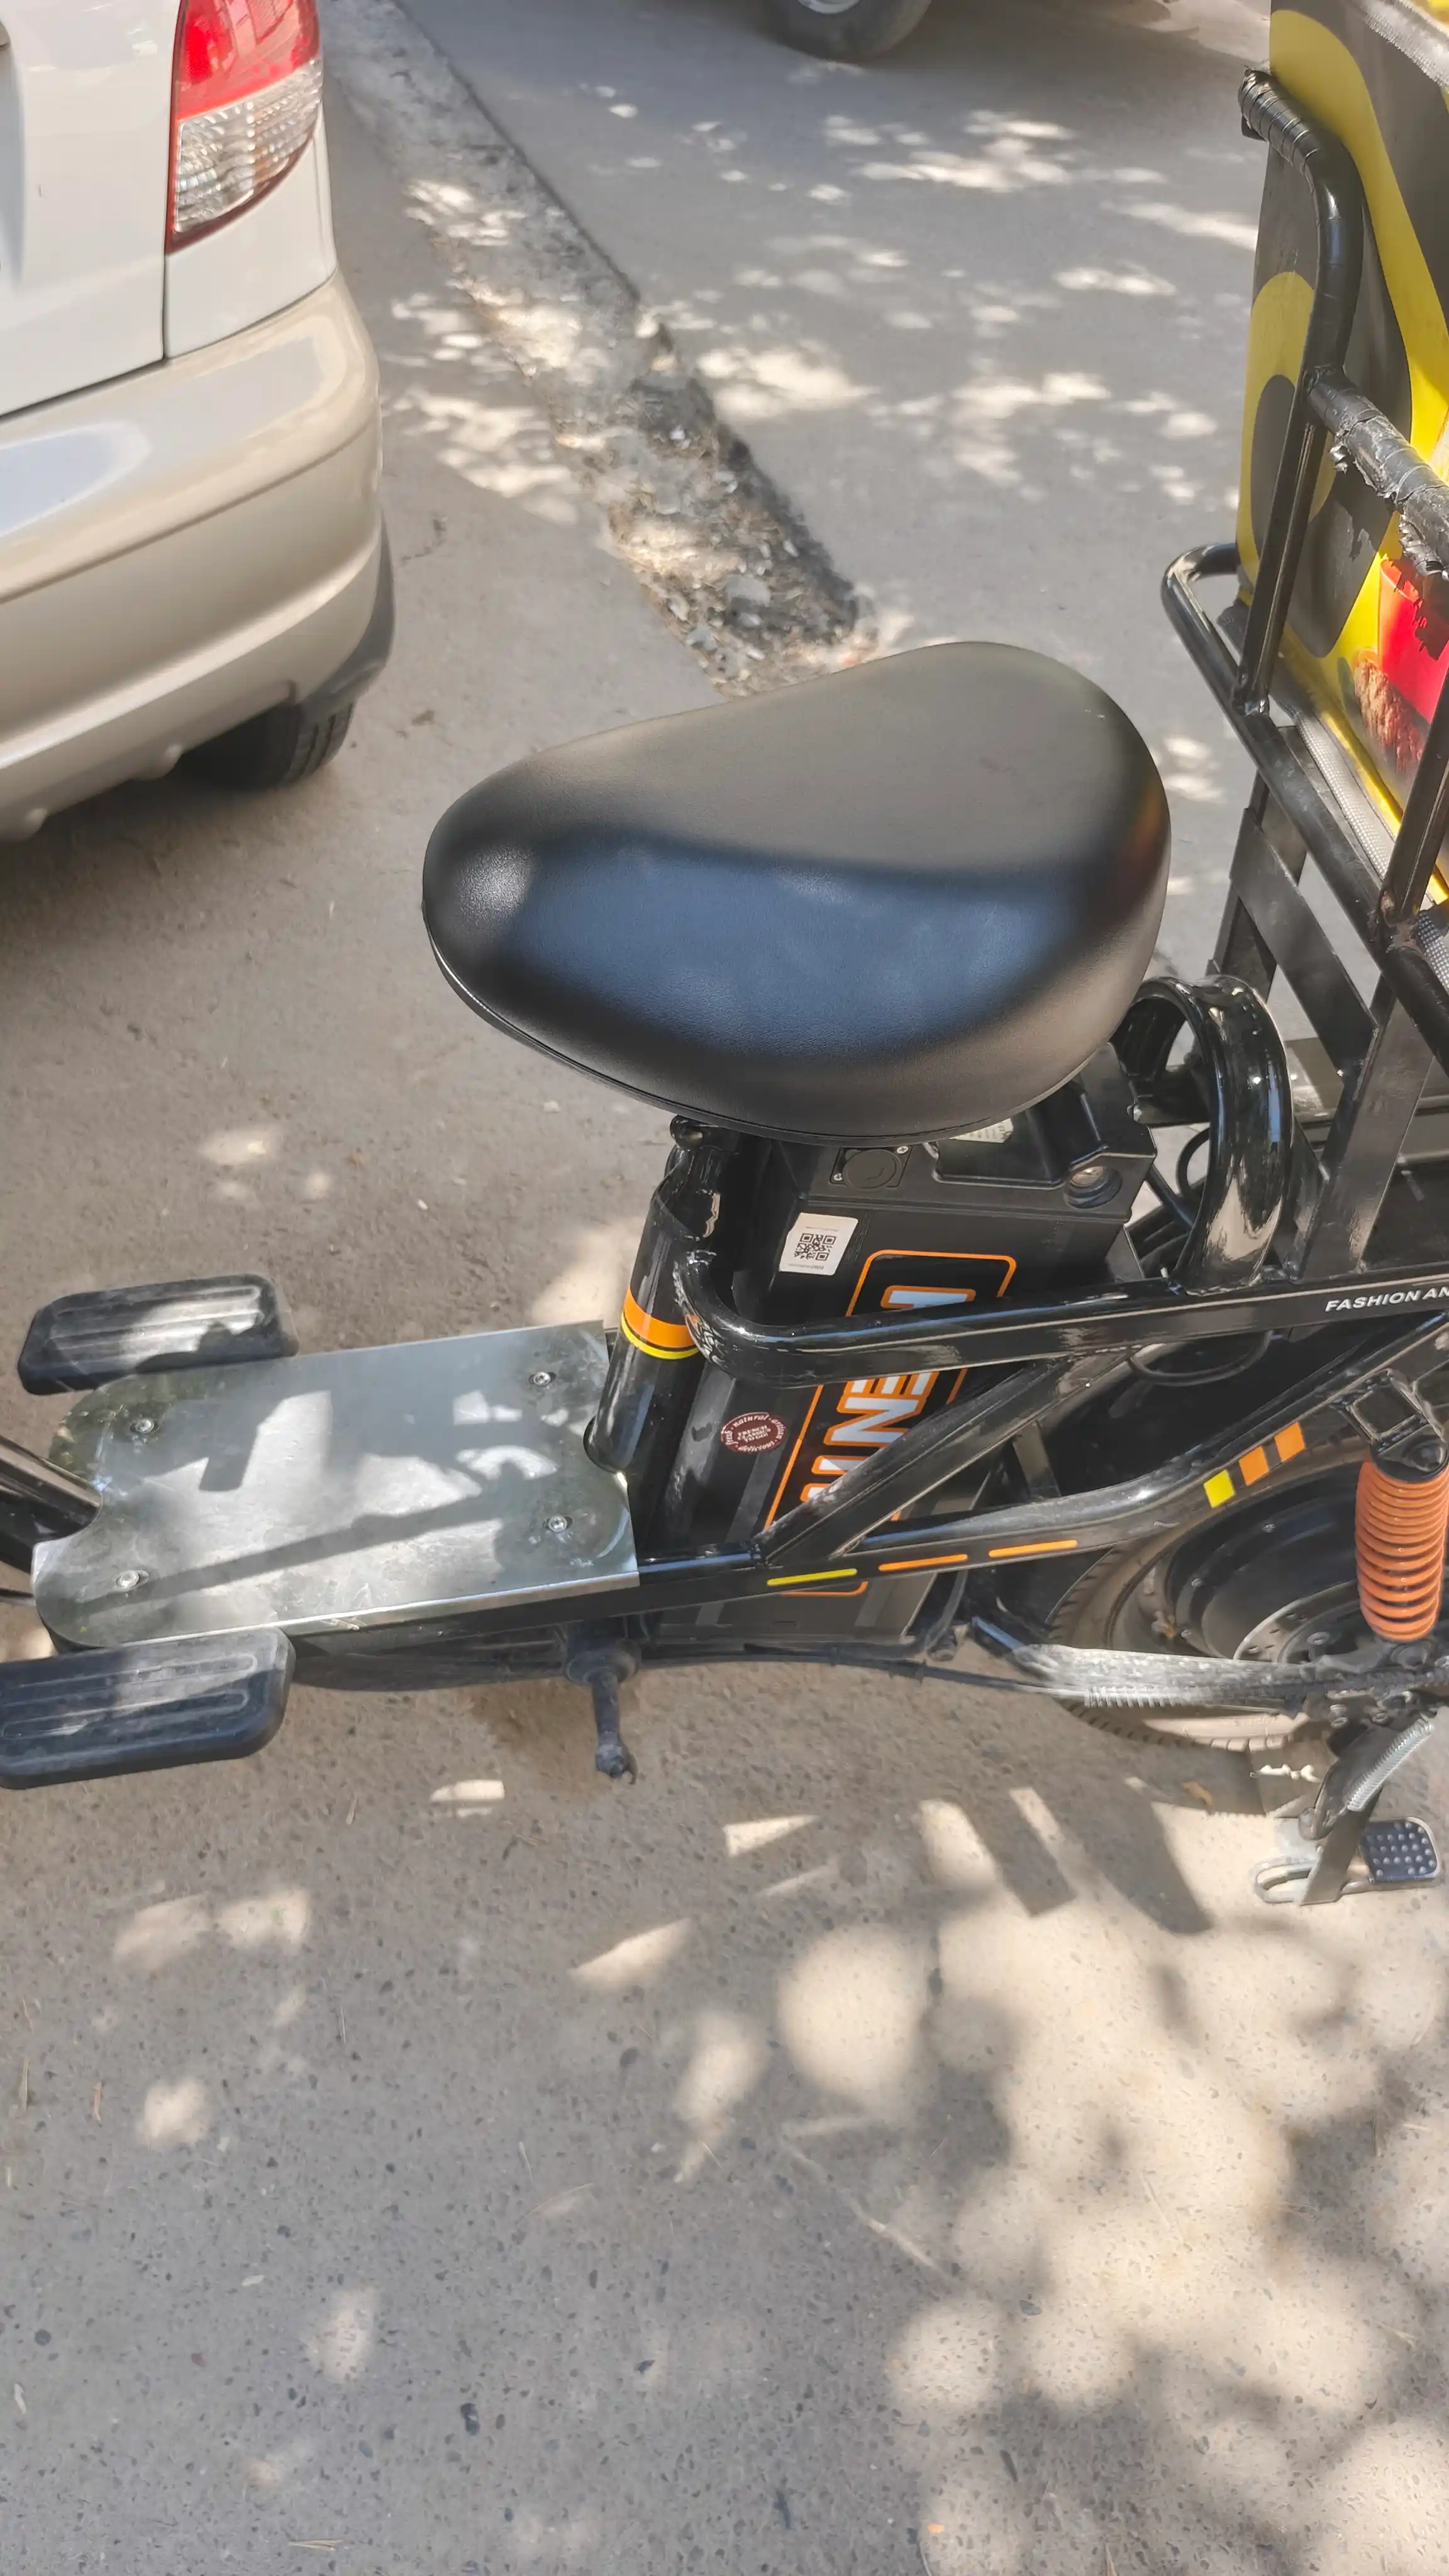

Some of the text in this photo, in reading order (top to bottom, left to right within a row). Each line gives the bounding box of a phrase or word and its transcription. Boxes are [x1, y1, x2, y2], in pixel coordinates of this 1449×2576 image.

[1325, 1290, 1422, 1312] FASHION
[733, 1414, 770, 1428] natural
[738, 1441, 775, 1452] delicious
